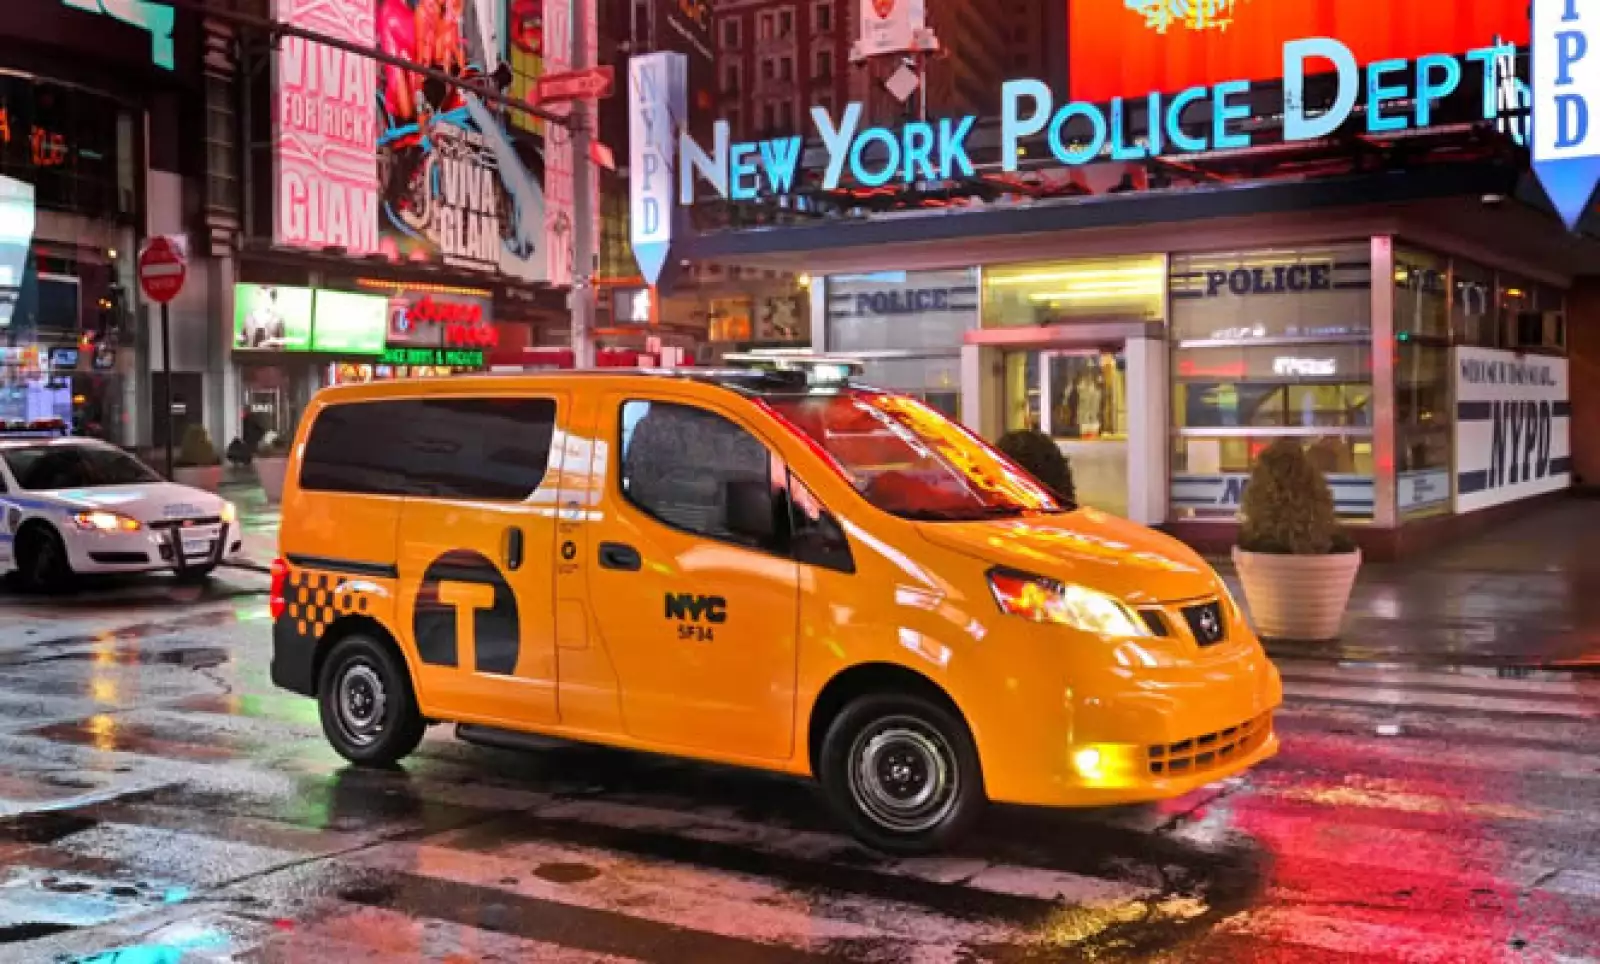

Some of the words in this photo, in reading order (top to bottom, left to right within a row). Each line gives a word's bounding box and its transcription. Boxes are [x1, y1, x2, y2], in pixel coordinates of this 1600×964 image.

[639, 64, 660, 235] NYPD
[1001, 78, 1251, 172] POLICE
[281, 171, 377, 251] GLAM
[440, 206, 499, 261] GLAM
[855, 287, 949, 316] POLICE
[1206, 263, 1333, 297] POLICE
[1488, 401, 1550, 489] NYPD
[664, 592, 727, 623] NYC
